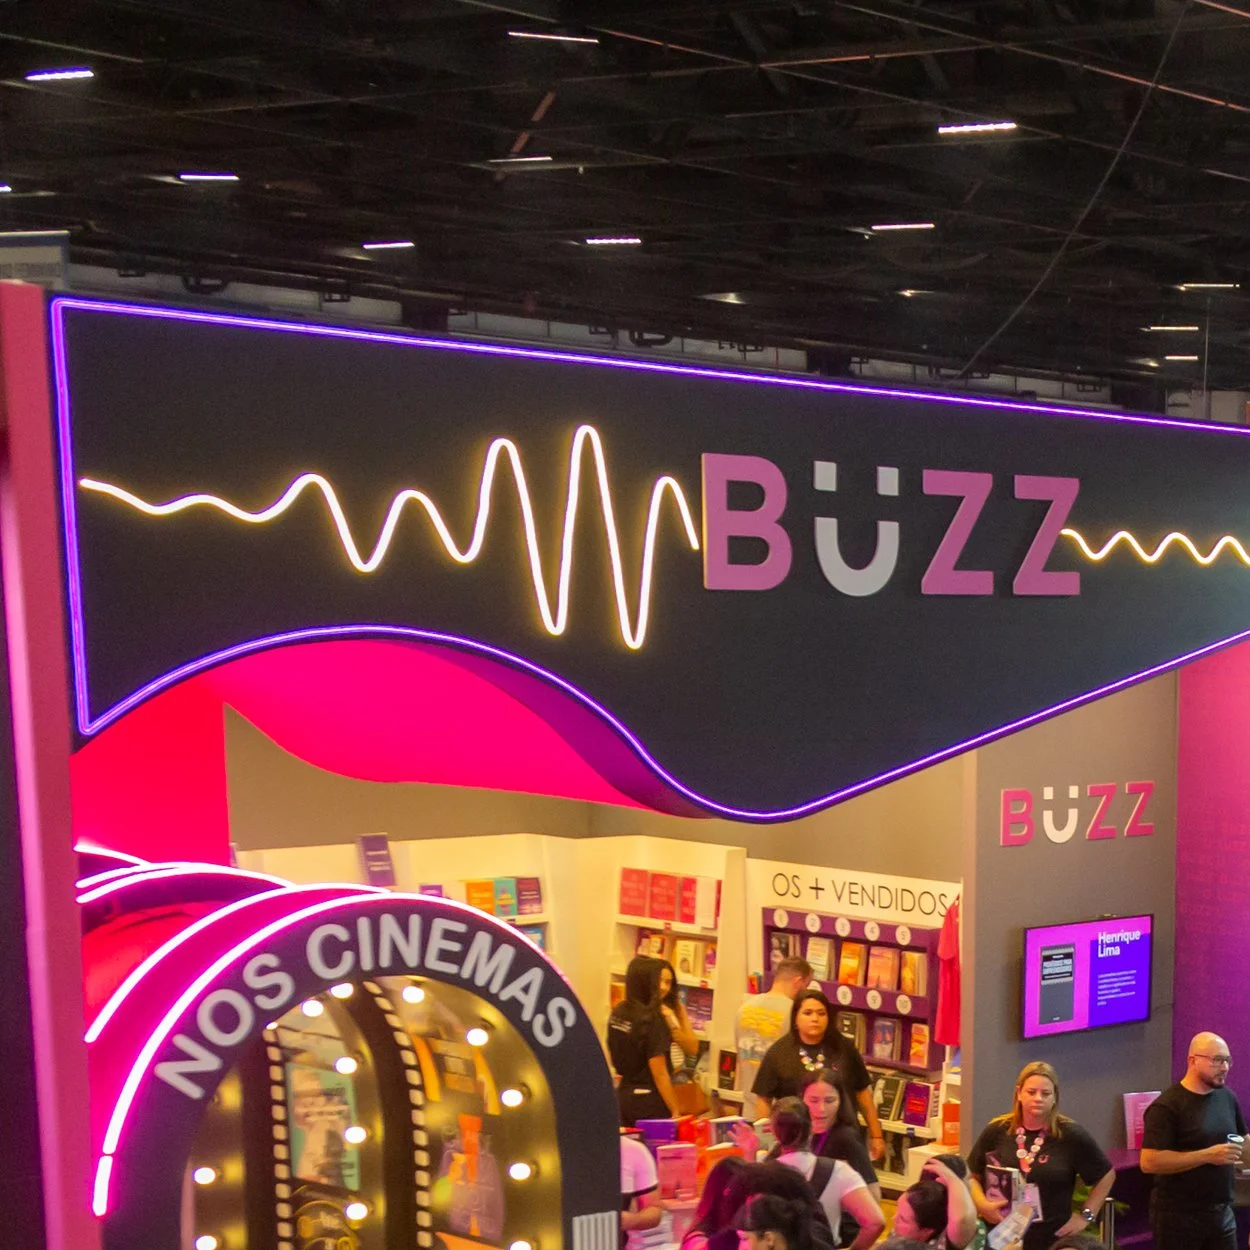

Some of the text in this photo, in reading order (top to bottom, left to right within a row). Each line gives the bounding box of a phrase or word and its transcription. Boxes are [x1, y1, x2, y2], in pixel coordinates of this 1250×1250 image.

[772, 873, 801, 898] OS
[832, 880, 948, 917] VENDIDOS
[1098, 930, 1141, 944] Henrique
[1098, 945, 1120, 958] Lima
[155, 913, 576, 1100] NOS CINEMAS
